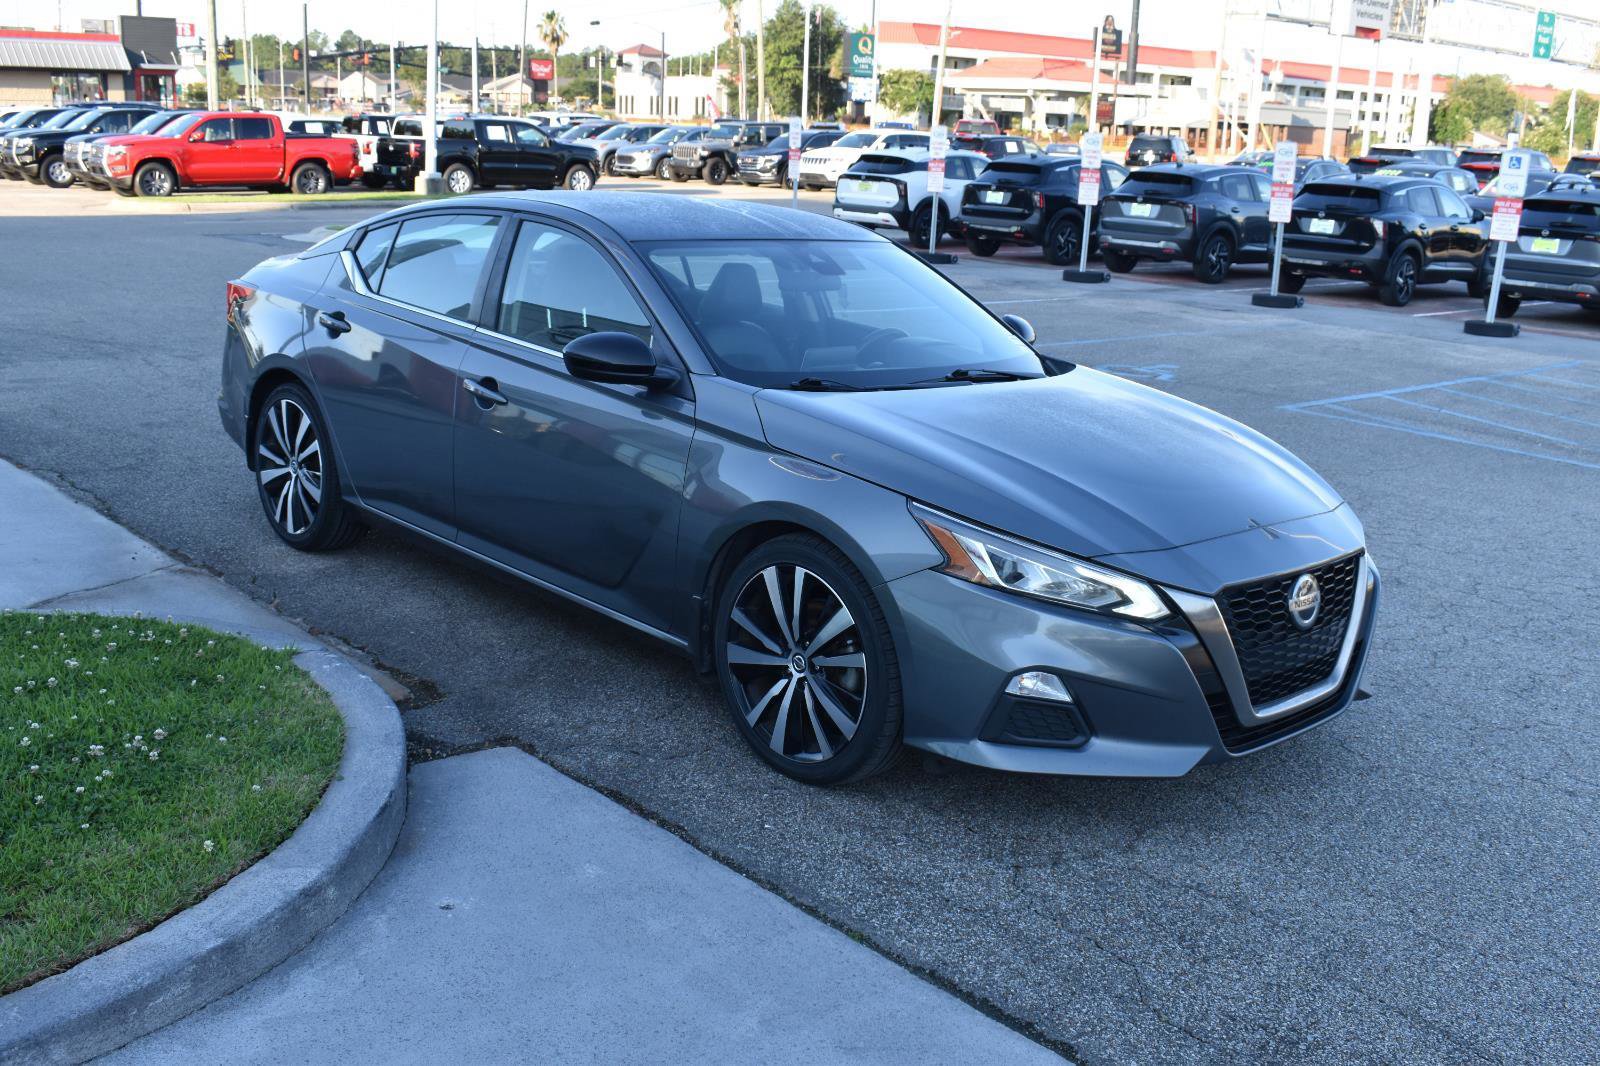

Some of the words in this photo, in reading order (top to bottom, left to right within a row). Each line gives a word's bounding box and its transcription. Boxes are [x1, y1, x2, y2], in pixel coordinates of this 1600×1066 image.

[1356, 8, 1383, 21] Vehicles
[859, 36, 872, 54] Q
[1294, 593, 1319, 608] NISSAN
